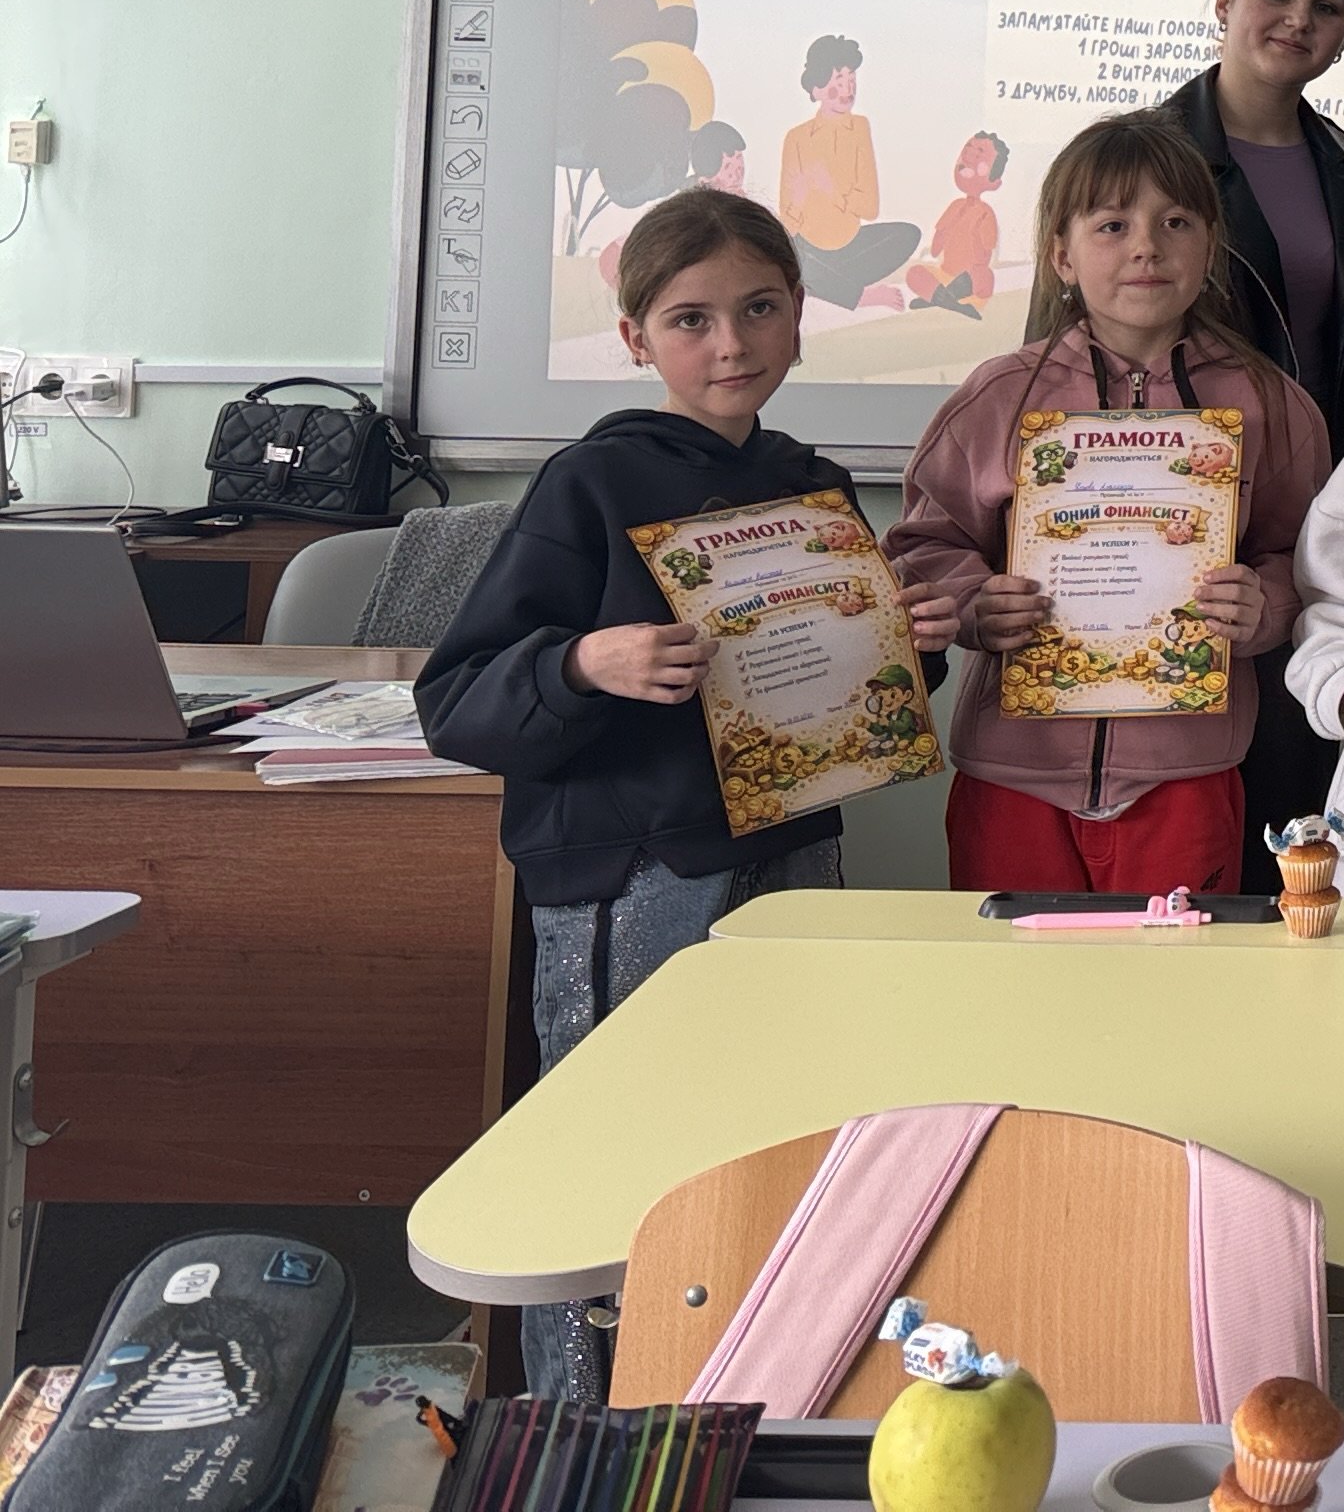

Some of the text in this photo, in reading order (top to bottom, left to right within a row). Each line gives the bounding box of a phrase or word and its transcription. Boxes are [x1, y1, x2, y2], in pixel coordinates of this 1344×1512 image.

[998, 11, 1109, 34] ЗАПАМ'ЯТАЙТЕ
[1114, 17, 1154, 36] НАШІ
[1078, 37, 1087, 57] 1
[1091, 39, 1140, 59] ГРОШІ
[1097, 62, 1107, 81] 2
[1010, 84, 1082, 105] ДРУЖБУ,
[1086, 85, 1139, 105] ЛЮБОВ
[1073, 431, 1185, 449] ГРАМОТА
[1053, 504, 1190, 524] ЮНИЙ ФІНАНСИСТ
[694, 518, 808, 554] ГРАМОТА
[719, 580, 852, 623] ЮНИЙ ФІНАНСИСТ
[172, 1448, 204, 1475] feel
[229, 1457, 254, 1486] you
